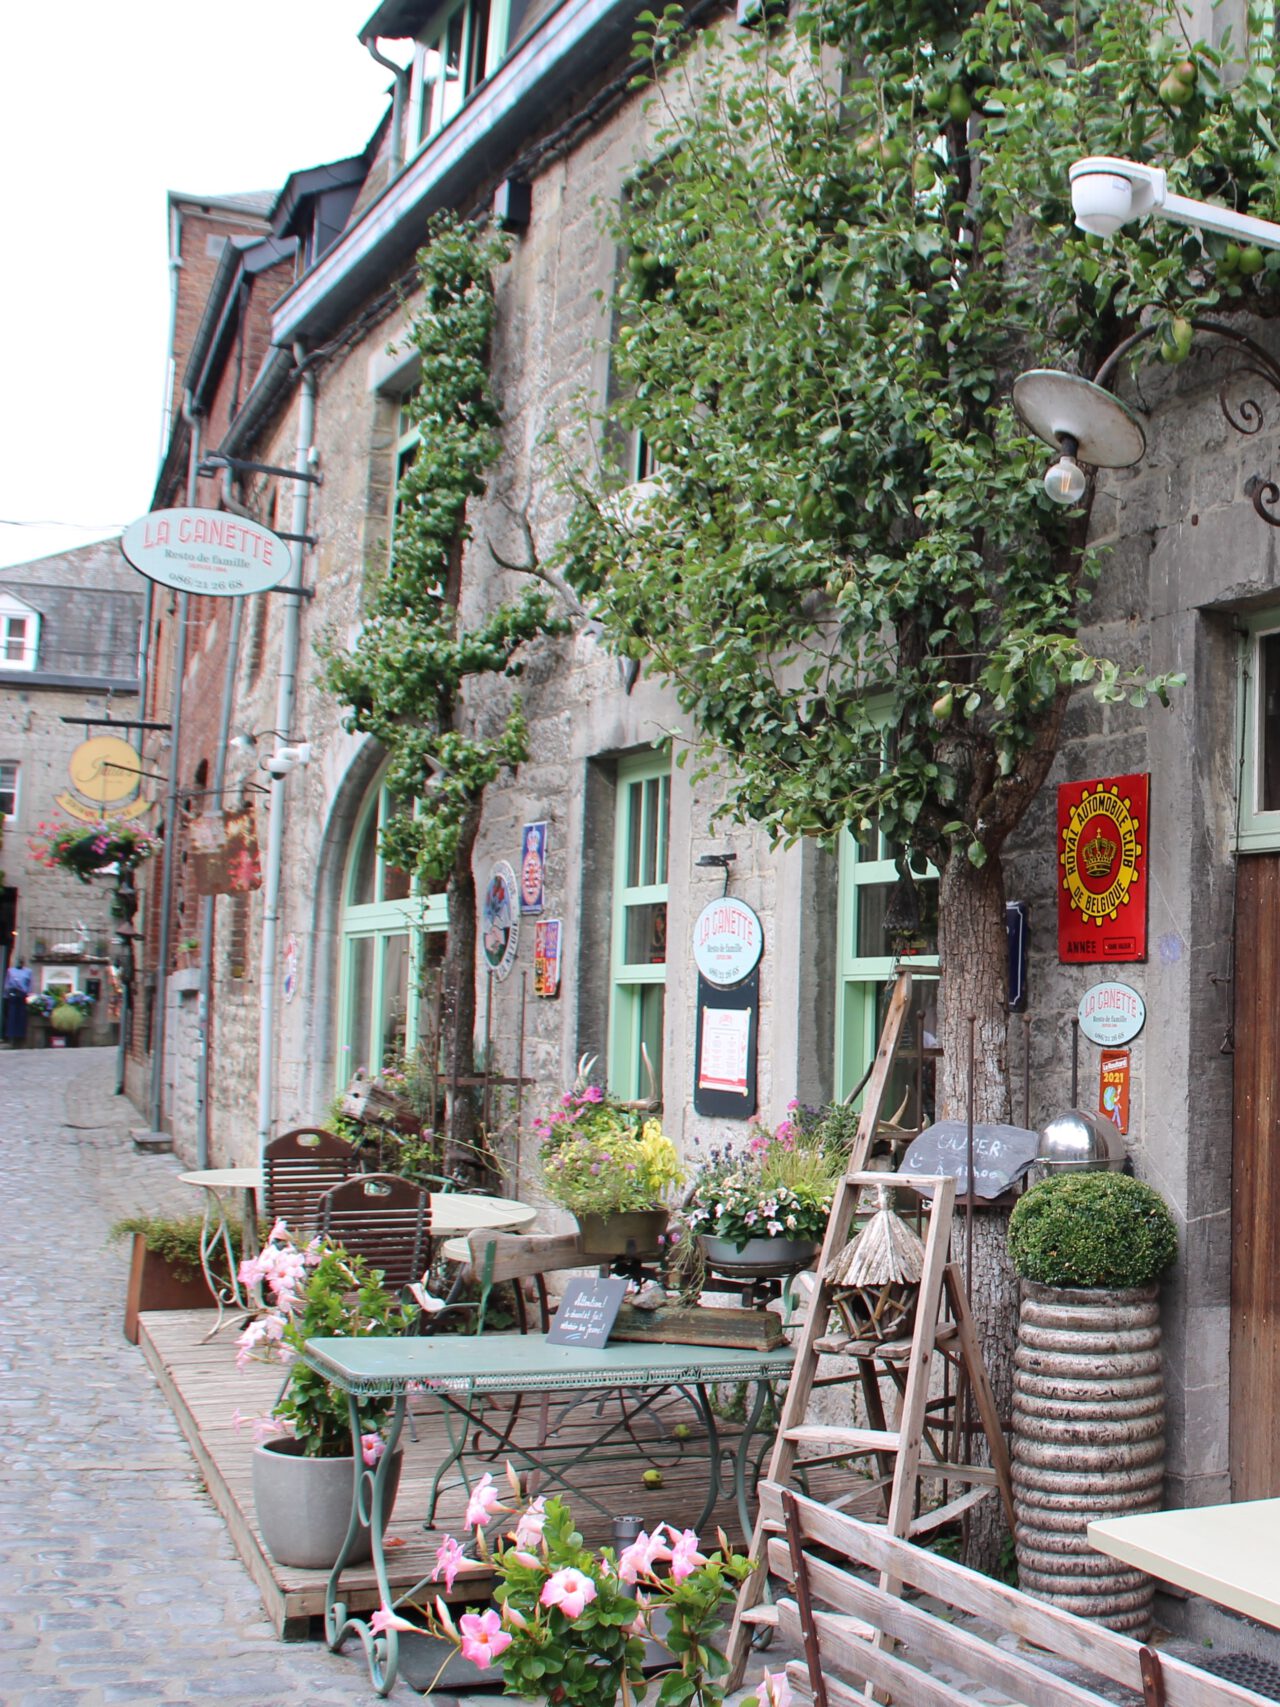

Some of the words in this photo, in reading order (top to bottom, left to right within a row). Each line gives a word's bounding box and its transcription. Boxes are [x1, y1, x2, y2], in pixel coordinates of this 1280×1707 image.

[144, 519, 170, 548] LA
[179, 517, 273, 566] CANETTE
[165, 549, 195, 561] Resto
[197, 553, 210, 563] de
[212, 555, 251, 568] famille
[1067, 827, 1079, 876] ROYAL
[1077, 795, 1128, 828] AUTOMOBILE
[1122, 829, 1136, 869] CLUB
[1073, 885, 1084, 904] DE
[1085, 878, 1127, 914] BELGIQUE
[700, 917, 709, 946] LA
[713, 906, 754, 946] CANETTE
[1085, 996, 1095, 1018] LA
[1098, 988, 1137, 1018] CANETTE
[1103, 1072, 1124, 1083] 2021
